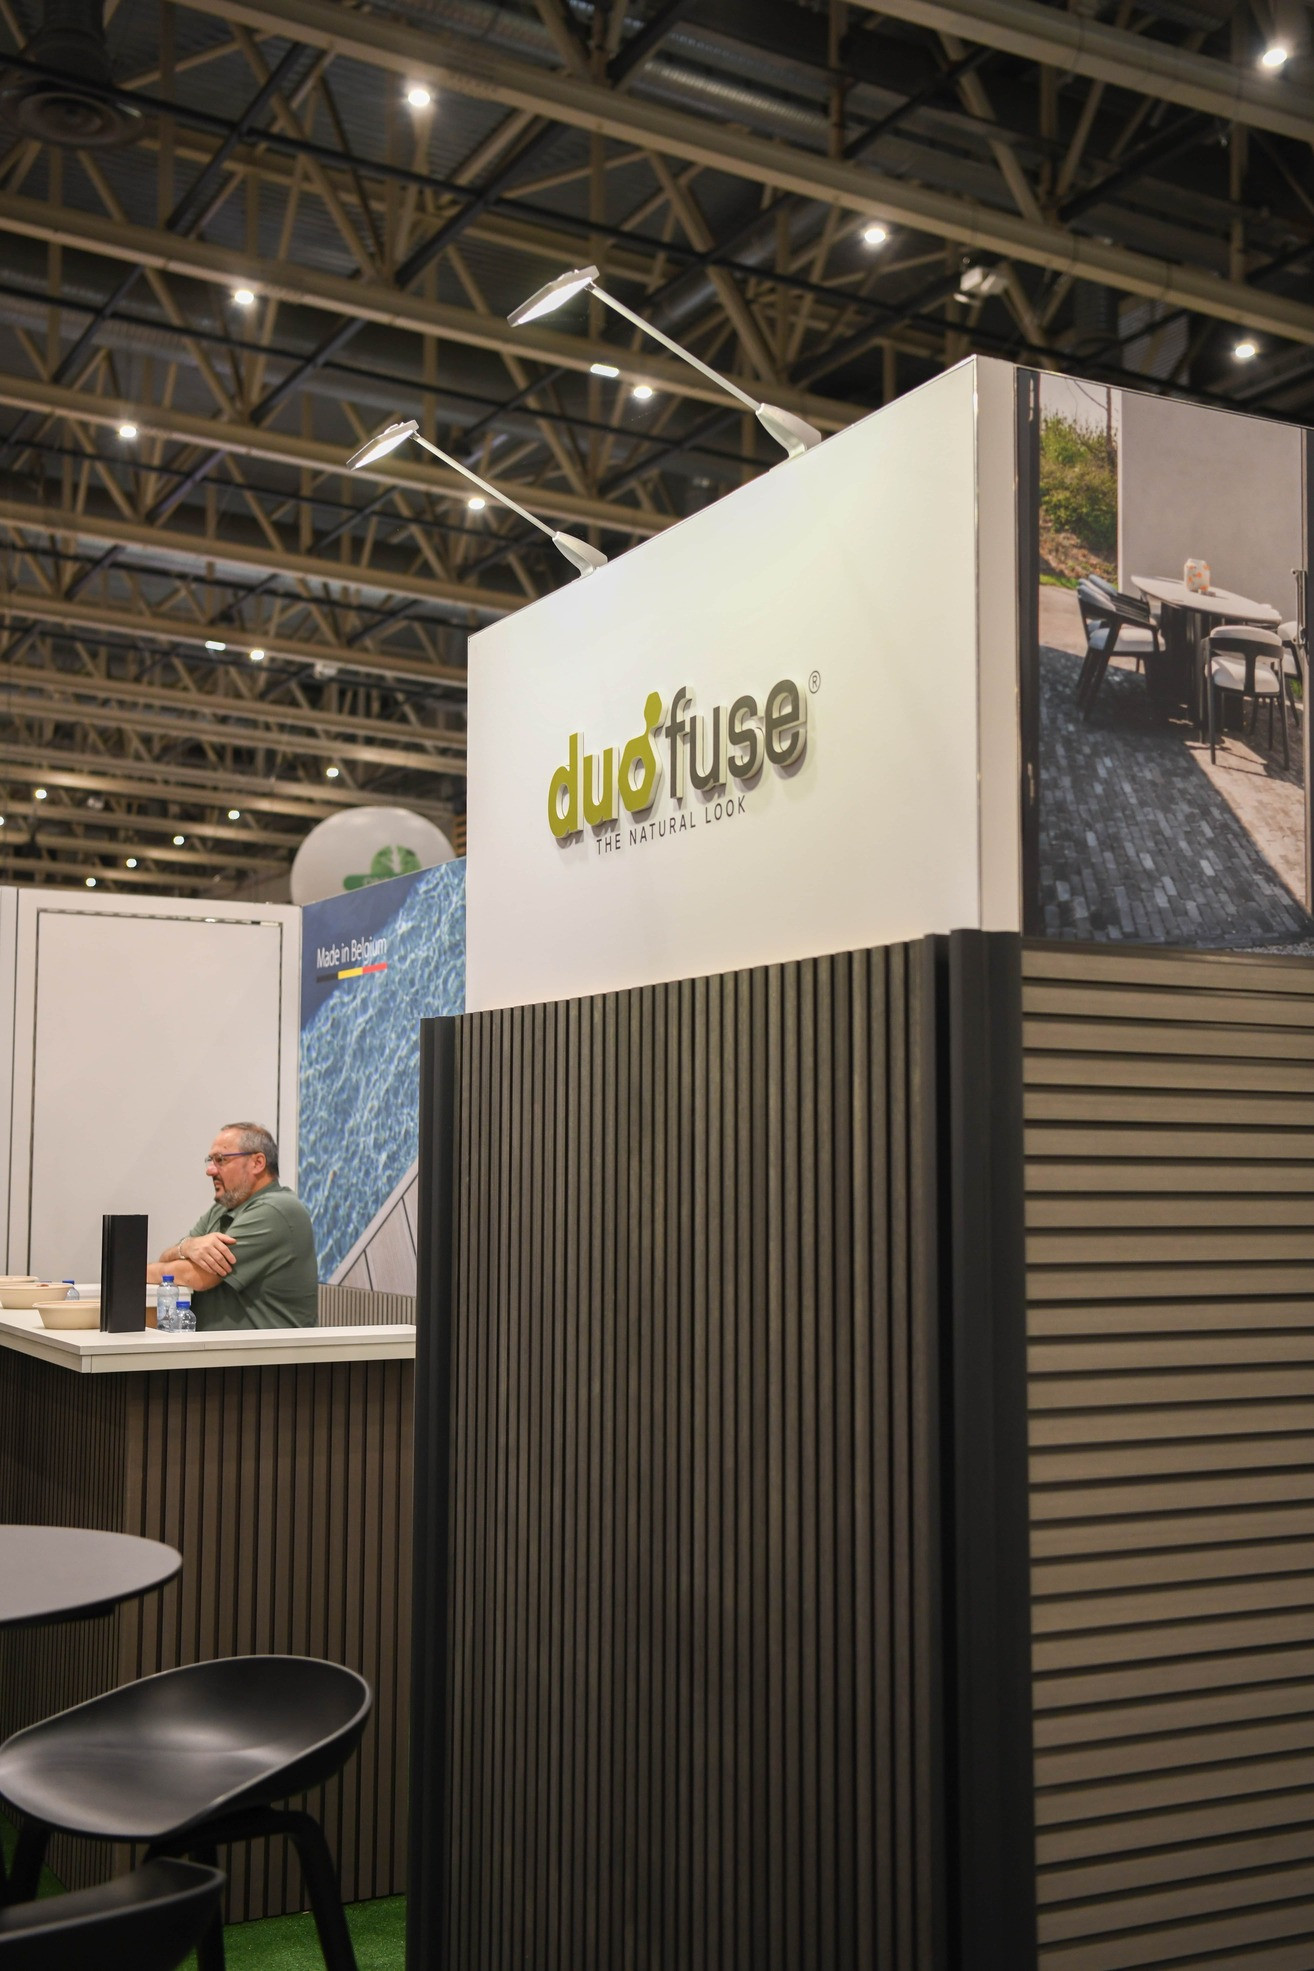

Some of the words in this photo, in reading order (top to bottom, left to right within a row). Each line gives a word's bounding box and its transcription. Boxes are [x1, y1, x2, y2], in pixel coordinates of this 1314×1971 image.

[596, 833, 621, 855] THE
[629, 812, 696, 846] NATURAL
[705, 795, 746, 824] LOOK
[316, 944, 340, 969] Made
[341, 943, 350, 963] in
[351, 936, 387, 965] Belgium
